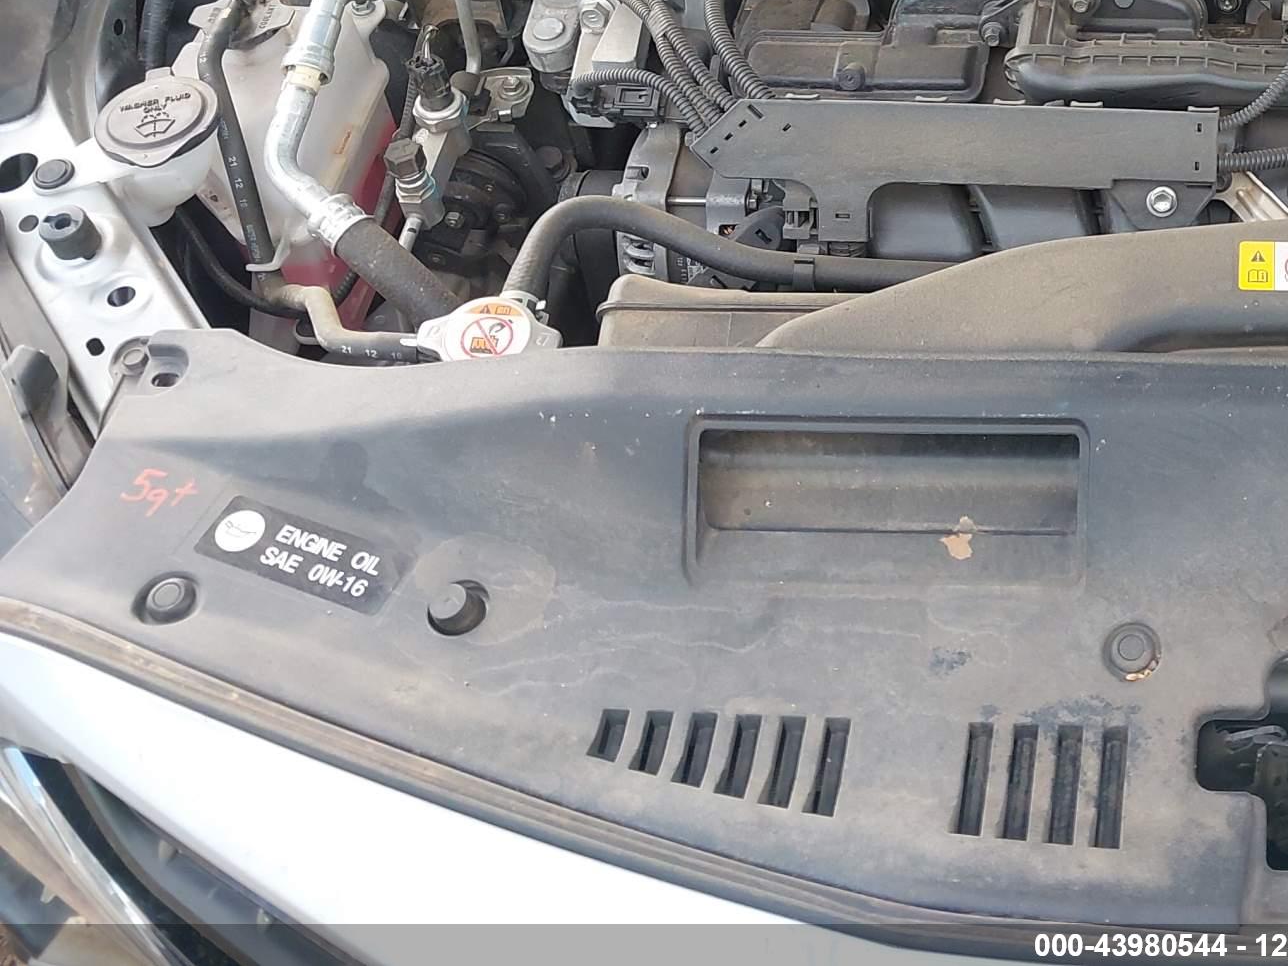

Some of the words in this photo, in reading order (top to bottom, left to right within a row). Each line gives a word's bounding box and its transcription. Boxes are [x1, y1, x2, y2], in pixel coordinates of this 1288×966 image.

[119, 98, 160, 112] WASHER
[165, 92, 191, 103] FLUID
[143, 103, 167, 114] ONLY
[228, 156, 239, 167] 21
[234, 177, 243, 189] 12
[341, 345, 352, 355] 21
[365, 348, 378, 358] 12
[275, 524, 347, 562] ENGINE
[350, 551, 380, 576] OIL
[259, 547, 303, 574] SAE
[307, 563, 369, 597] 0W-16
